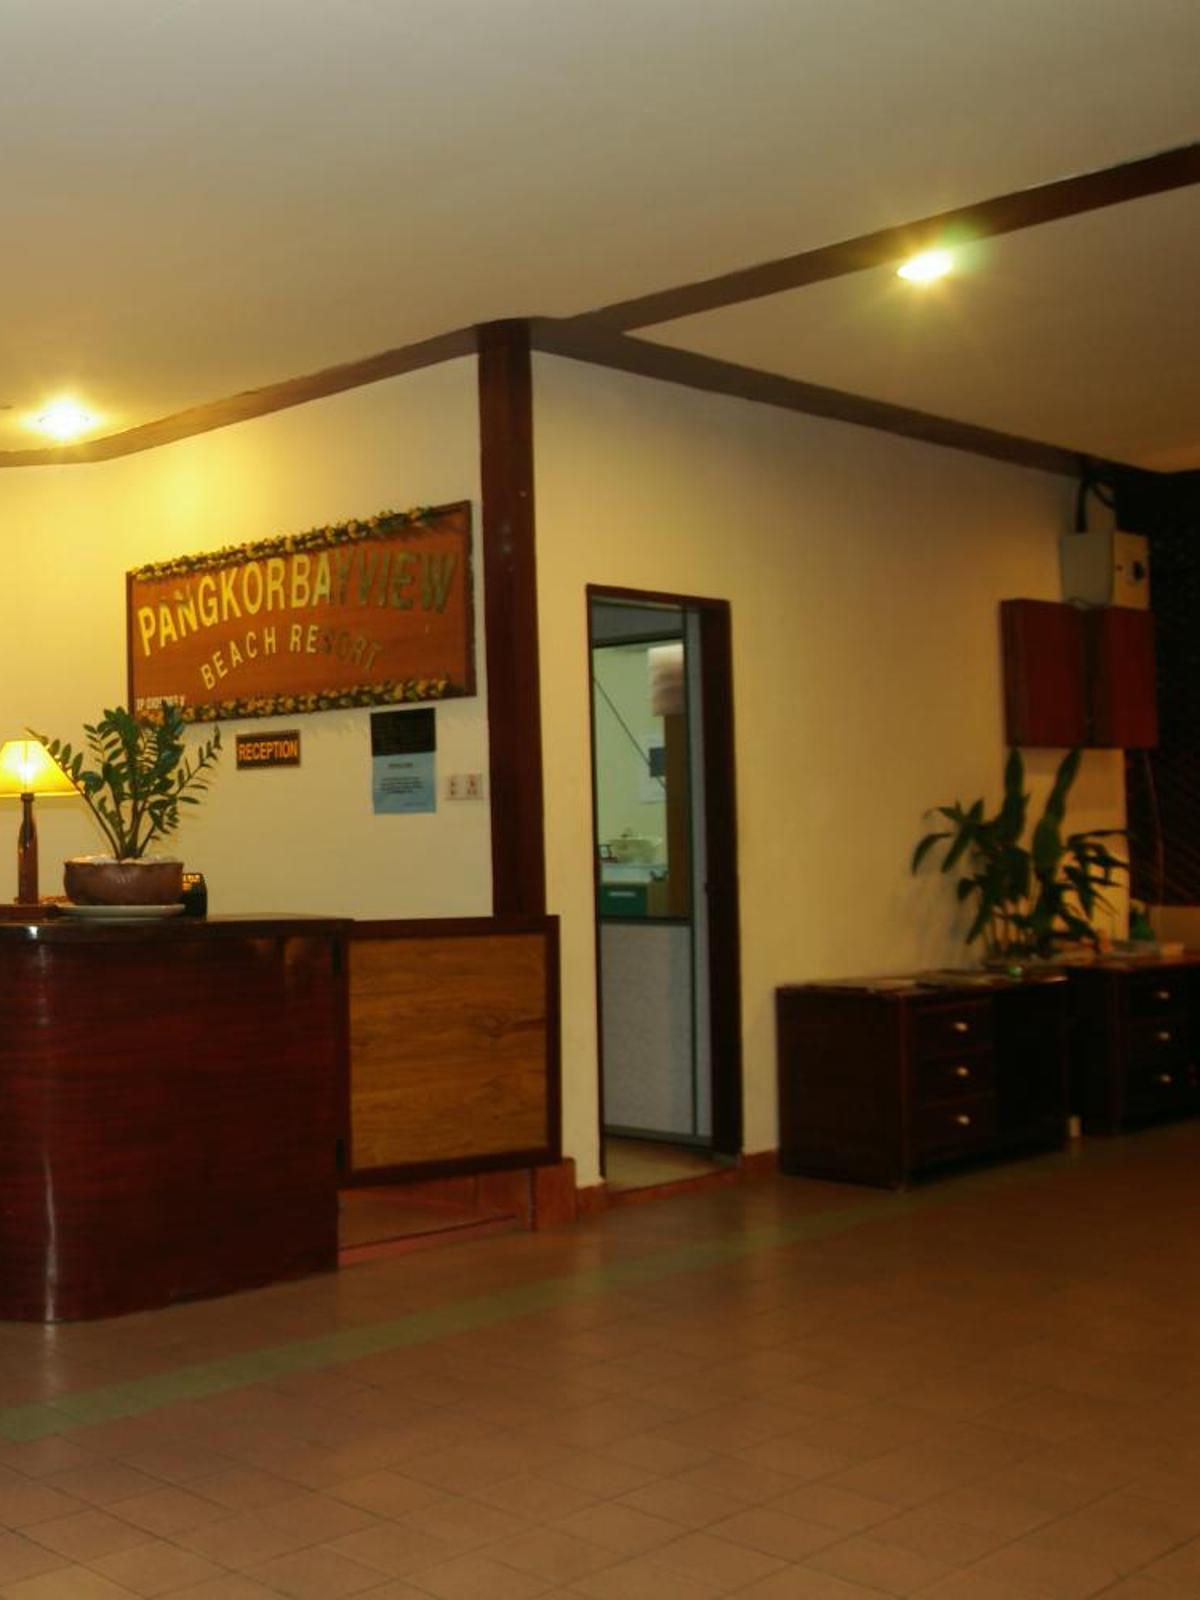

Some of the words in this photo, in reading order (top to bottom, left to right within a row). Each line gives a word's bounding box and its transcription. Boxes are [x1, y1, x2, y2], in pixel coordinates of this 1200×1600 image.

[201, 627, 277, 690] BEACH
[290, 624, 384, 672] RESORT
[238, 739, 298, 762] RECEPTION
